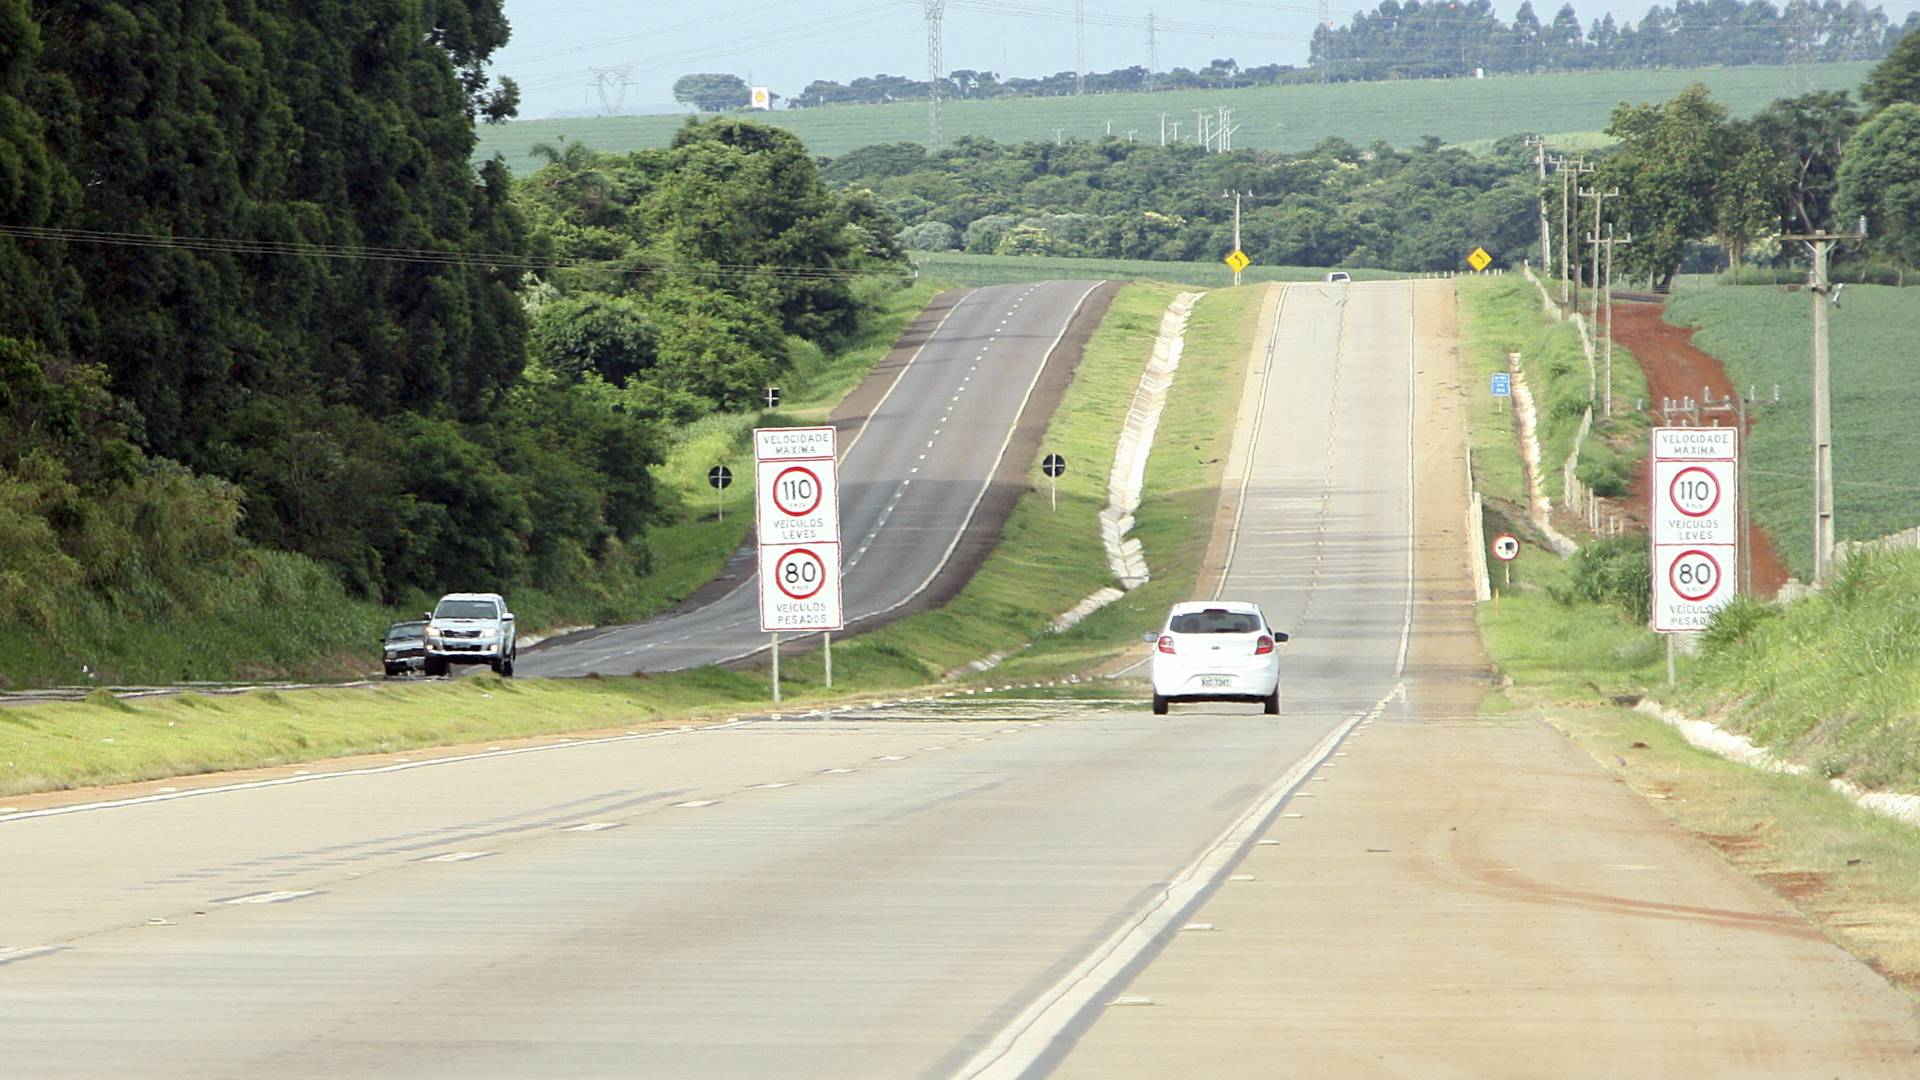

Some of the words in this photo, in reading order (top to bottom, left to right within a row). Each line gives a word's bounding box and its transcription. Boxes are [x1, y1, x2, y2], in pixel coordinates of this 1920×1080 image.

[763, 433, 829, 445] VELOCIDADE
[1662, 434, 1729, 445] VELOCIDADE
[783, 479, 812, 500] 110
[1679, 480, 1709, 501] 110
[782, 529, 816, 540] LEVES
[1679, 530, 1713, 540] LEVES
[785, 561, 816, 584] 80
[1679, 563, 1711, 584] 80
[777, 614, 827, 624] PESADOS
